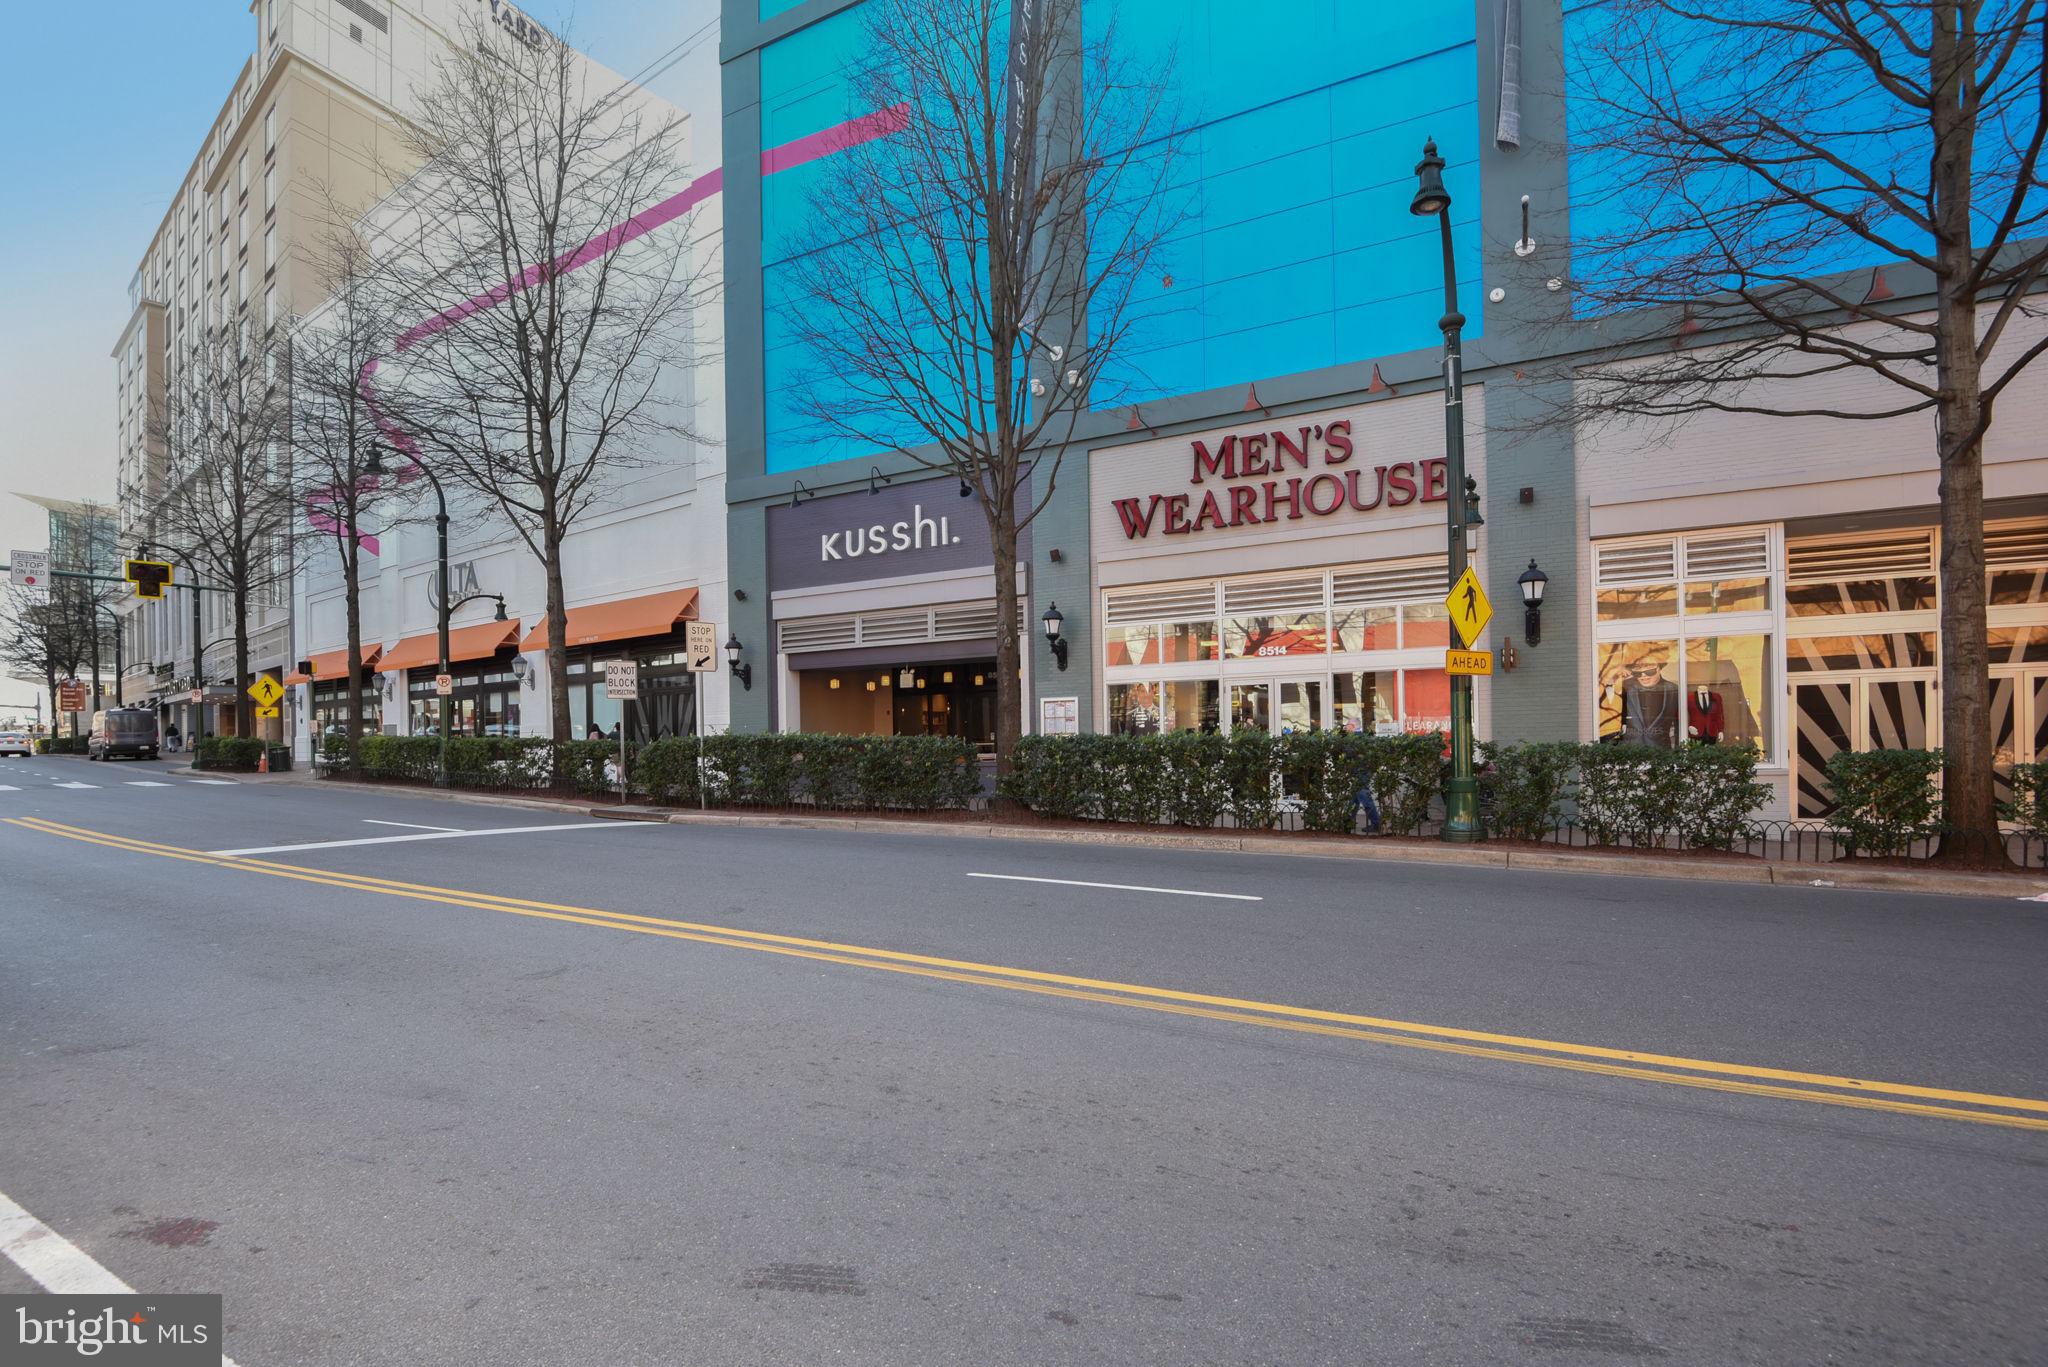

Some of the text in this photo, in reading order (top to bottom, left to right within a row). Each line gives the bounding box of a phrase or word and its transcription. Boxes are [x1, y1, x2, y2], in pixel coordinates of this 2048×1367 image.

[1190, 420, 1354, 484] MEN'S
[1111, 456, 1449, 540] WEARHOUSE
[691, 626, 711, 635] STOP
[693, 645, 709, 653] RED
[1258, 646, 1287, 656] 8514
[1452, 656, 1487, 669] AHEAD
[608, 666, 635, 675] DO NOT
[608, 678, 635, 687] BLOCK
